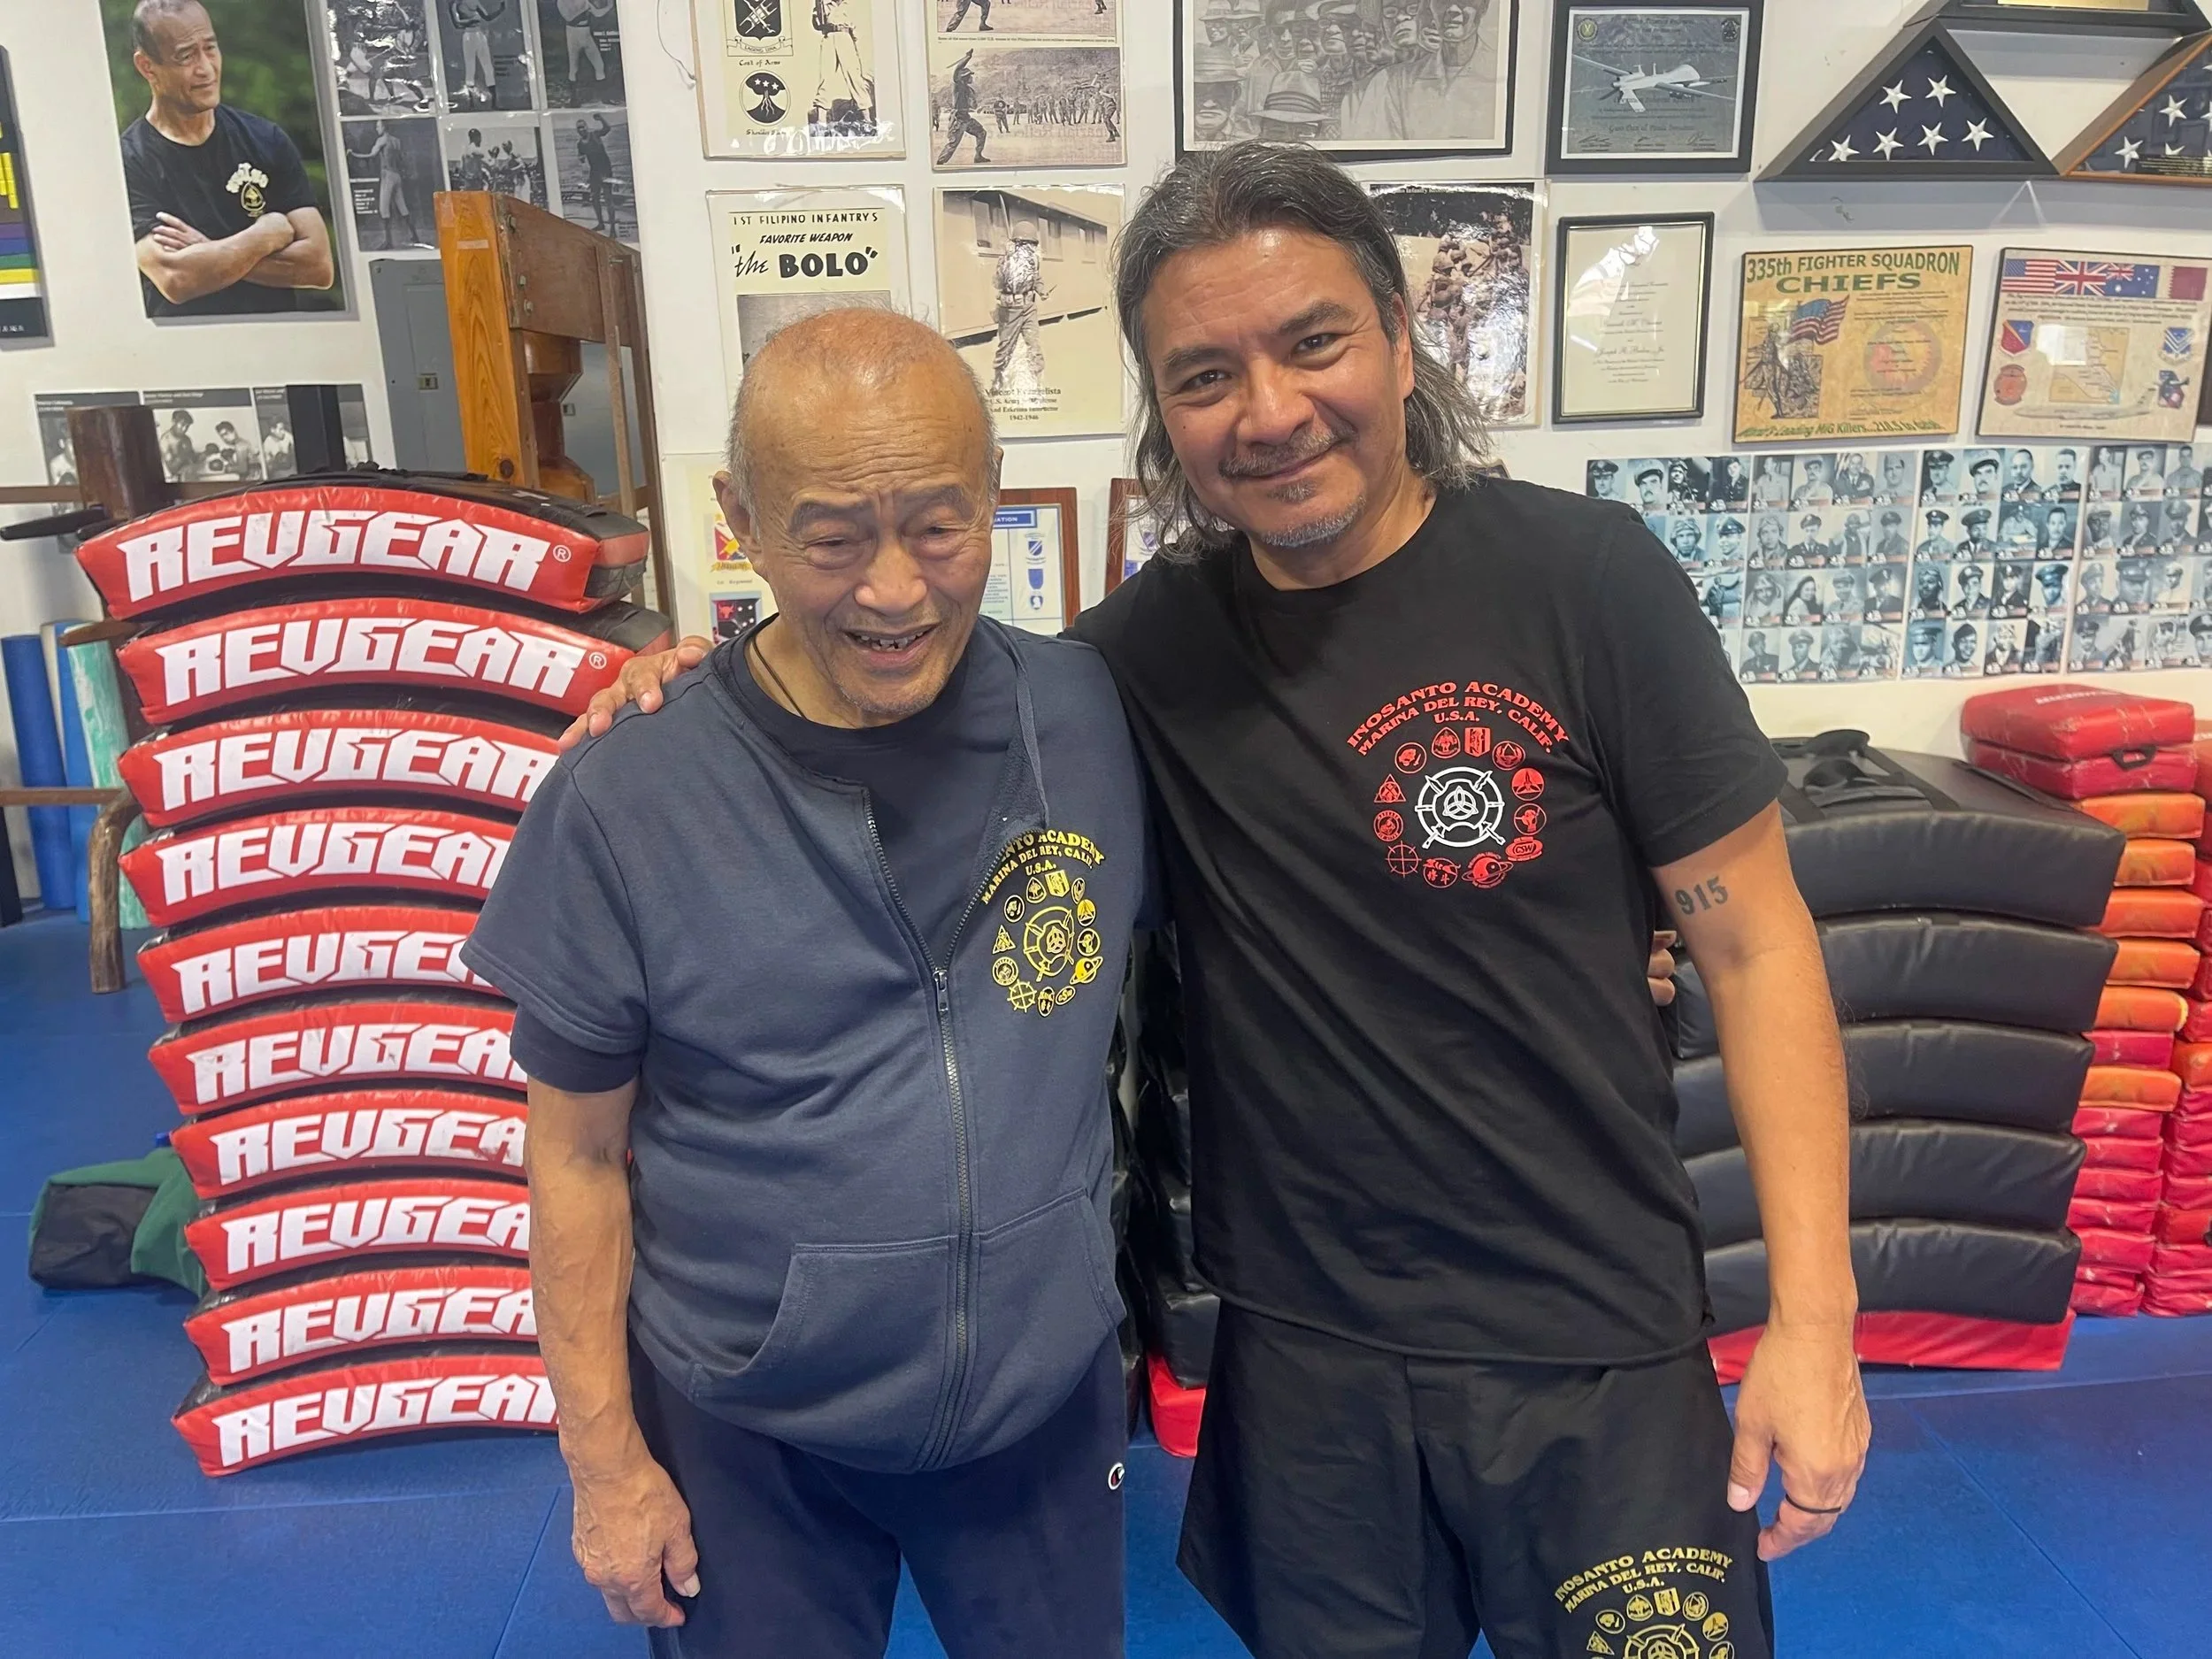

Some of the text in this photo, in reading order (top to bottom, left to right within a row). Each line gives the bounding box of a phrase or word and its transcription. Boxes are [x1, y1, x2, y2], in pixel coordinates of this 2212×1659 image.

[759, 214, 806, 224] FILIPINO
[759, 233, 854, 244] FAVORITE WEAPON
[1747, 251, 1960, 283] 335th FIGHTER SQUADRON
[1776, 273, 1921, 294] CHIEFS
[1348, 680, 1570, 749] INOSANTO ACADEMY
[1358, 696, 1554, 756] MARINA DEL REY, CALIF.
[1432, 710, 1480, 724] U.S.A.
[981, 859, 1018, 905] MARINA
[1019, 848, 1038, 864] DEL
[1025, 859, 1056, 876] U.S.A.
[1675, 875, 1728, 915] 915
[171, 931, 500, 1015] REVGE
[185, 1024, 529, 1105] REVGEA
[209, 1109, 527, 1186] REVGEA
[221, 1196, 531, 1275] REVGEA
[221, 1287, 538, 1374] REVGEA
[1555, 1548, 1733, 1601] INOSANTO ACADEMY
[1564, 1579, 1609, 1614] MARINA
[1609, 1568, 1641, 1586] DEL
[1686, 1563, 1726, 1583] CALIF.
[1622, 1576, 1665, 1594] U.S.A.
